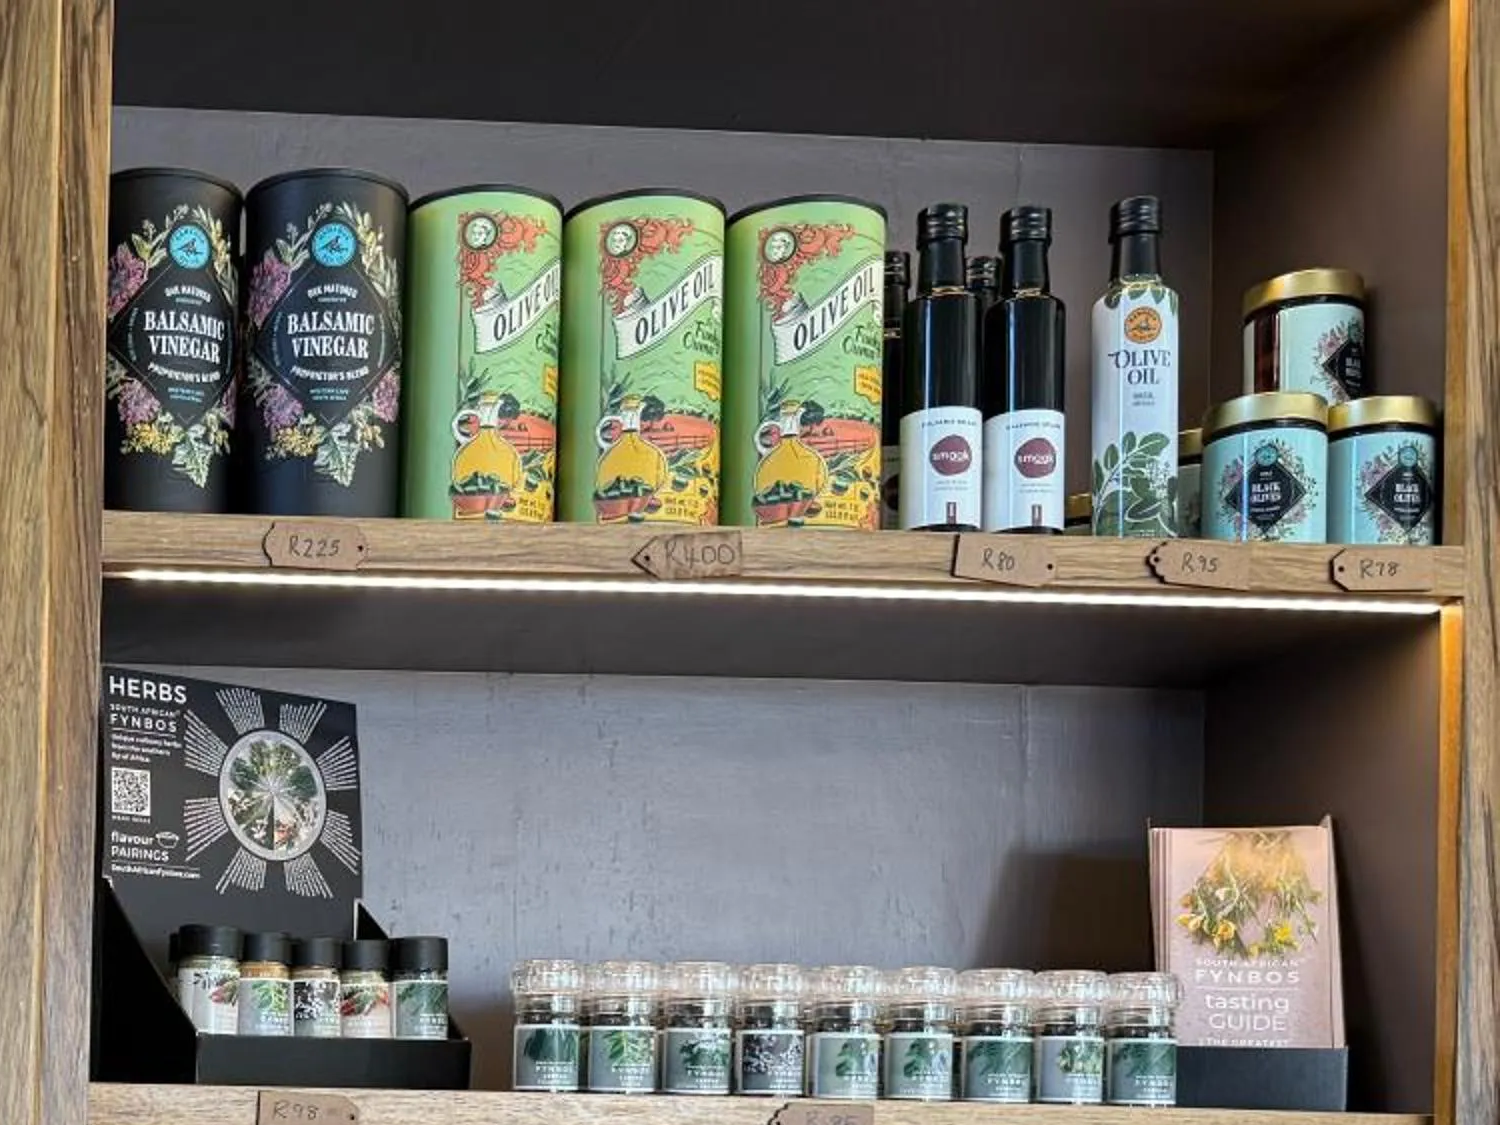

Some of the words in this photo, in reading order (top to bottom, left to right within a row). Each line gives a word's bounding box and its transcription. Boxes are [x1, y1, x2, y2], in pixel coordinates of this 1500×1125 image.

[494, 279, 542, 342] OLIVE
[635, 281, 690, 346] OLIVE
[693, 264, 717, 300] OIL
[794, 286, 849, 350] OLIVE
[852, 269, 876, 304] OIL
[144, 310, 224, 341] BALSAMIC
[287, 310, 374, 335] BALSAMIC
[149, 335, 220, 364] VINEGAR
[292, 335, 368, 359] VINEGAR
[1108, 349, 1171, 368] OLIVE
[1127, 368, 1159, 385] OIL
[289, 534, 341, 558] R225
[664, 542, 735, 569] R400
[109, 675, 187, 704] HERBS
[110, 713, 177, 732] FYNBOS
[111, 830, 155, 845] flavour
[111, 845, 169, 862] PAIRINGS
[1195, 969, 1300, 984] FYNBOS
[1205, 994, 1289, 1014] tasting
[1209, 1014, 1287, 1032] GUIDE
